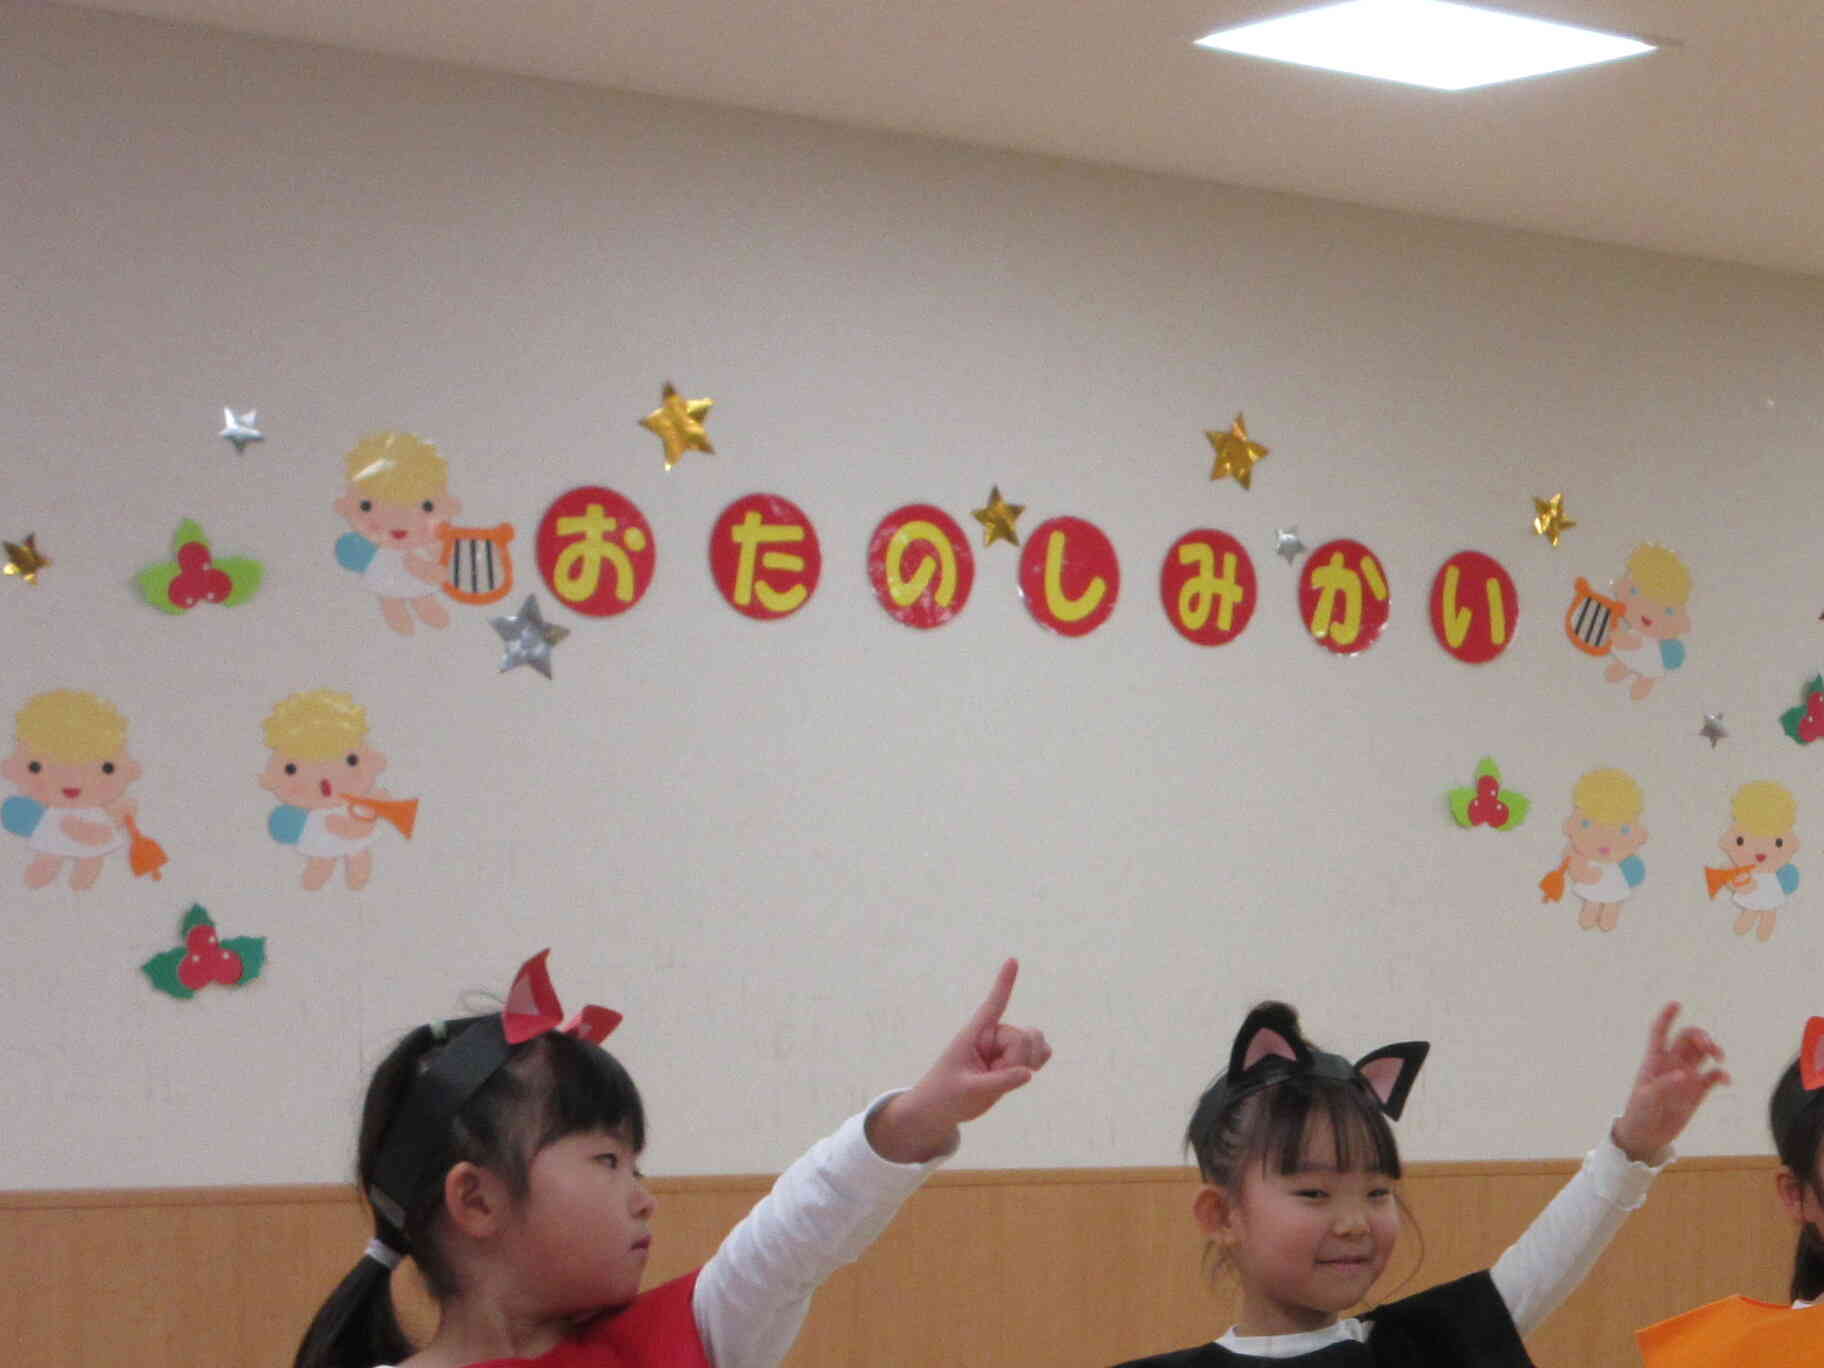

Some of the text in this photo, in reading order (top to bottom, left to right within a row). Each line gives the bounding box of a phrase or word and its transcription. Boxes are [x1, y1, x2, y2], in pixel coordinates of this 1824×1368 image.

[554, 504, 1507, 650] おたのしみかい
